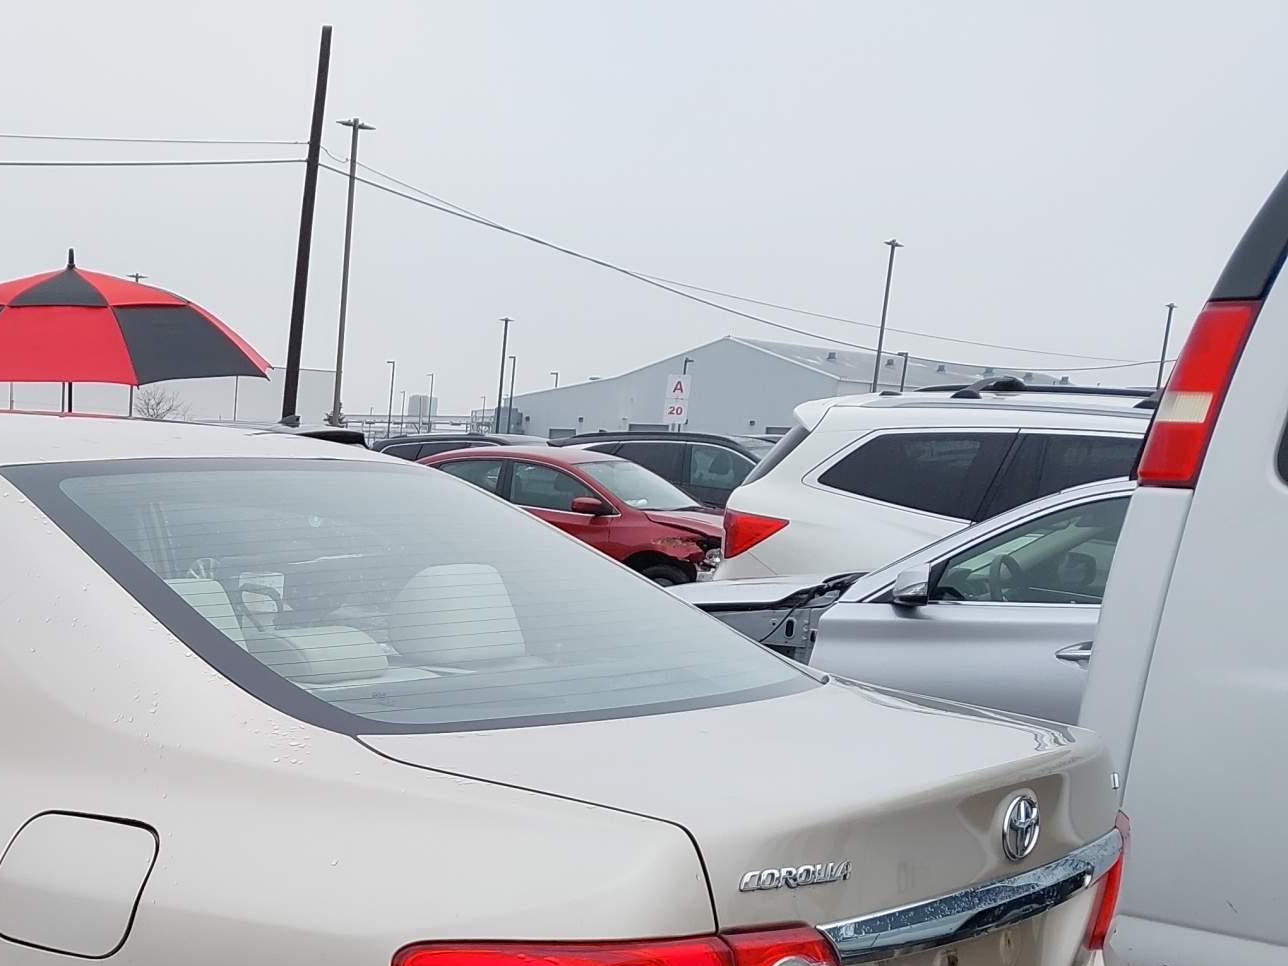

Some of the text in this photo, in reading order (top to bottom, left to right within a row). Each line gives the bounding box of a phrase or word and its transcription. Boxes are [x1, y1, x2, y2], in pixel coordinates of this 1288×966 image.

[672, 380, 684, 393] A
[667, 405, 683, 416] 20
[739, 860, 852, 893] COROLLA
